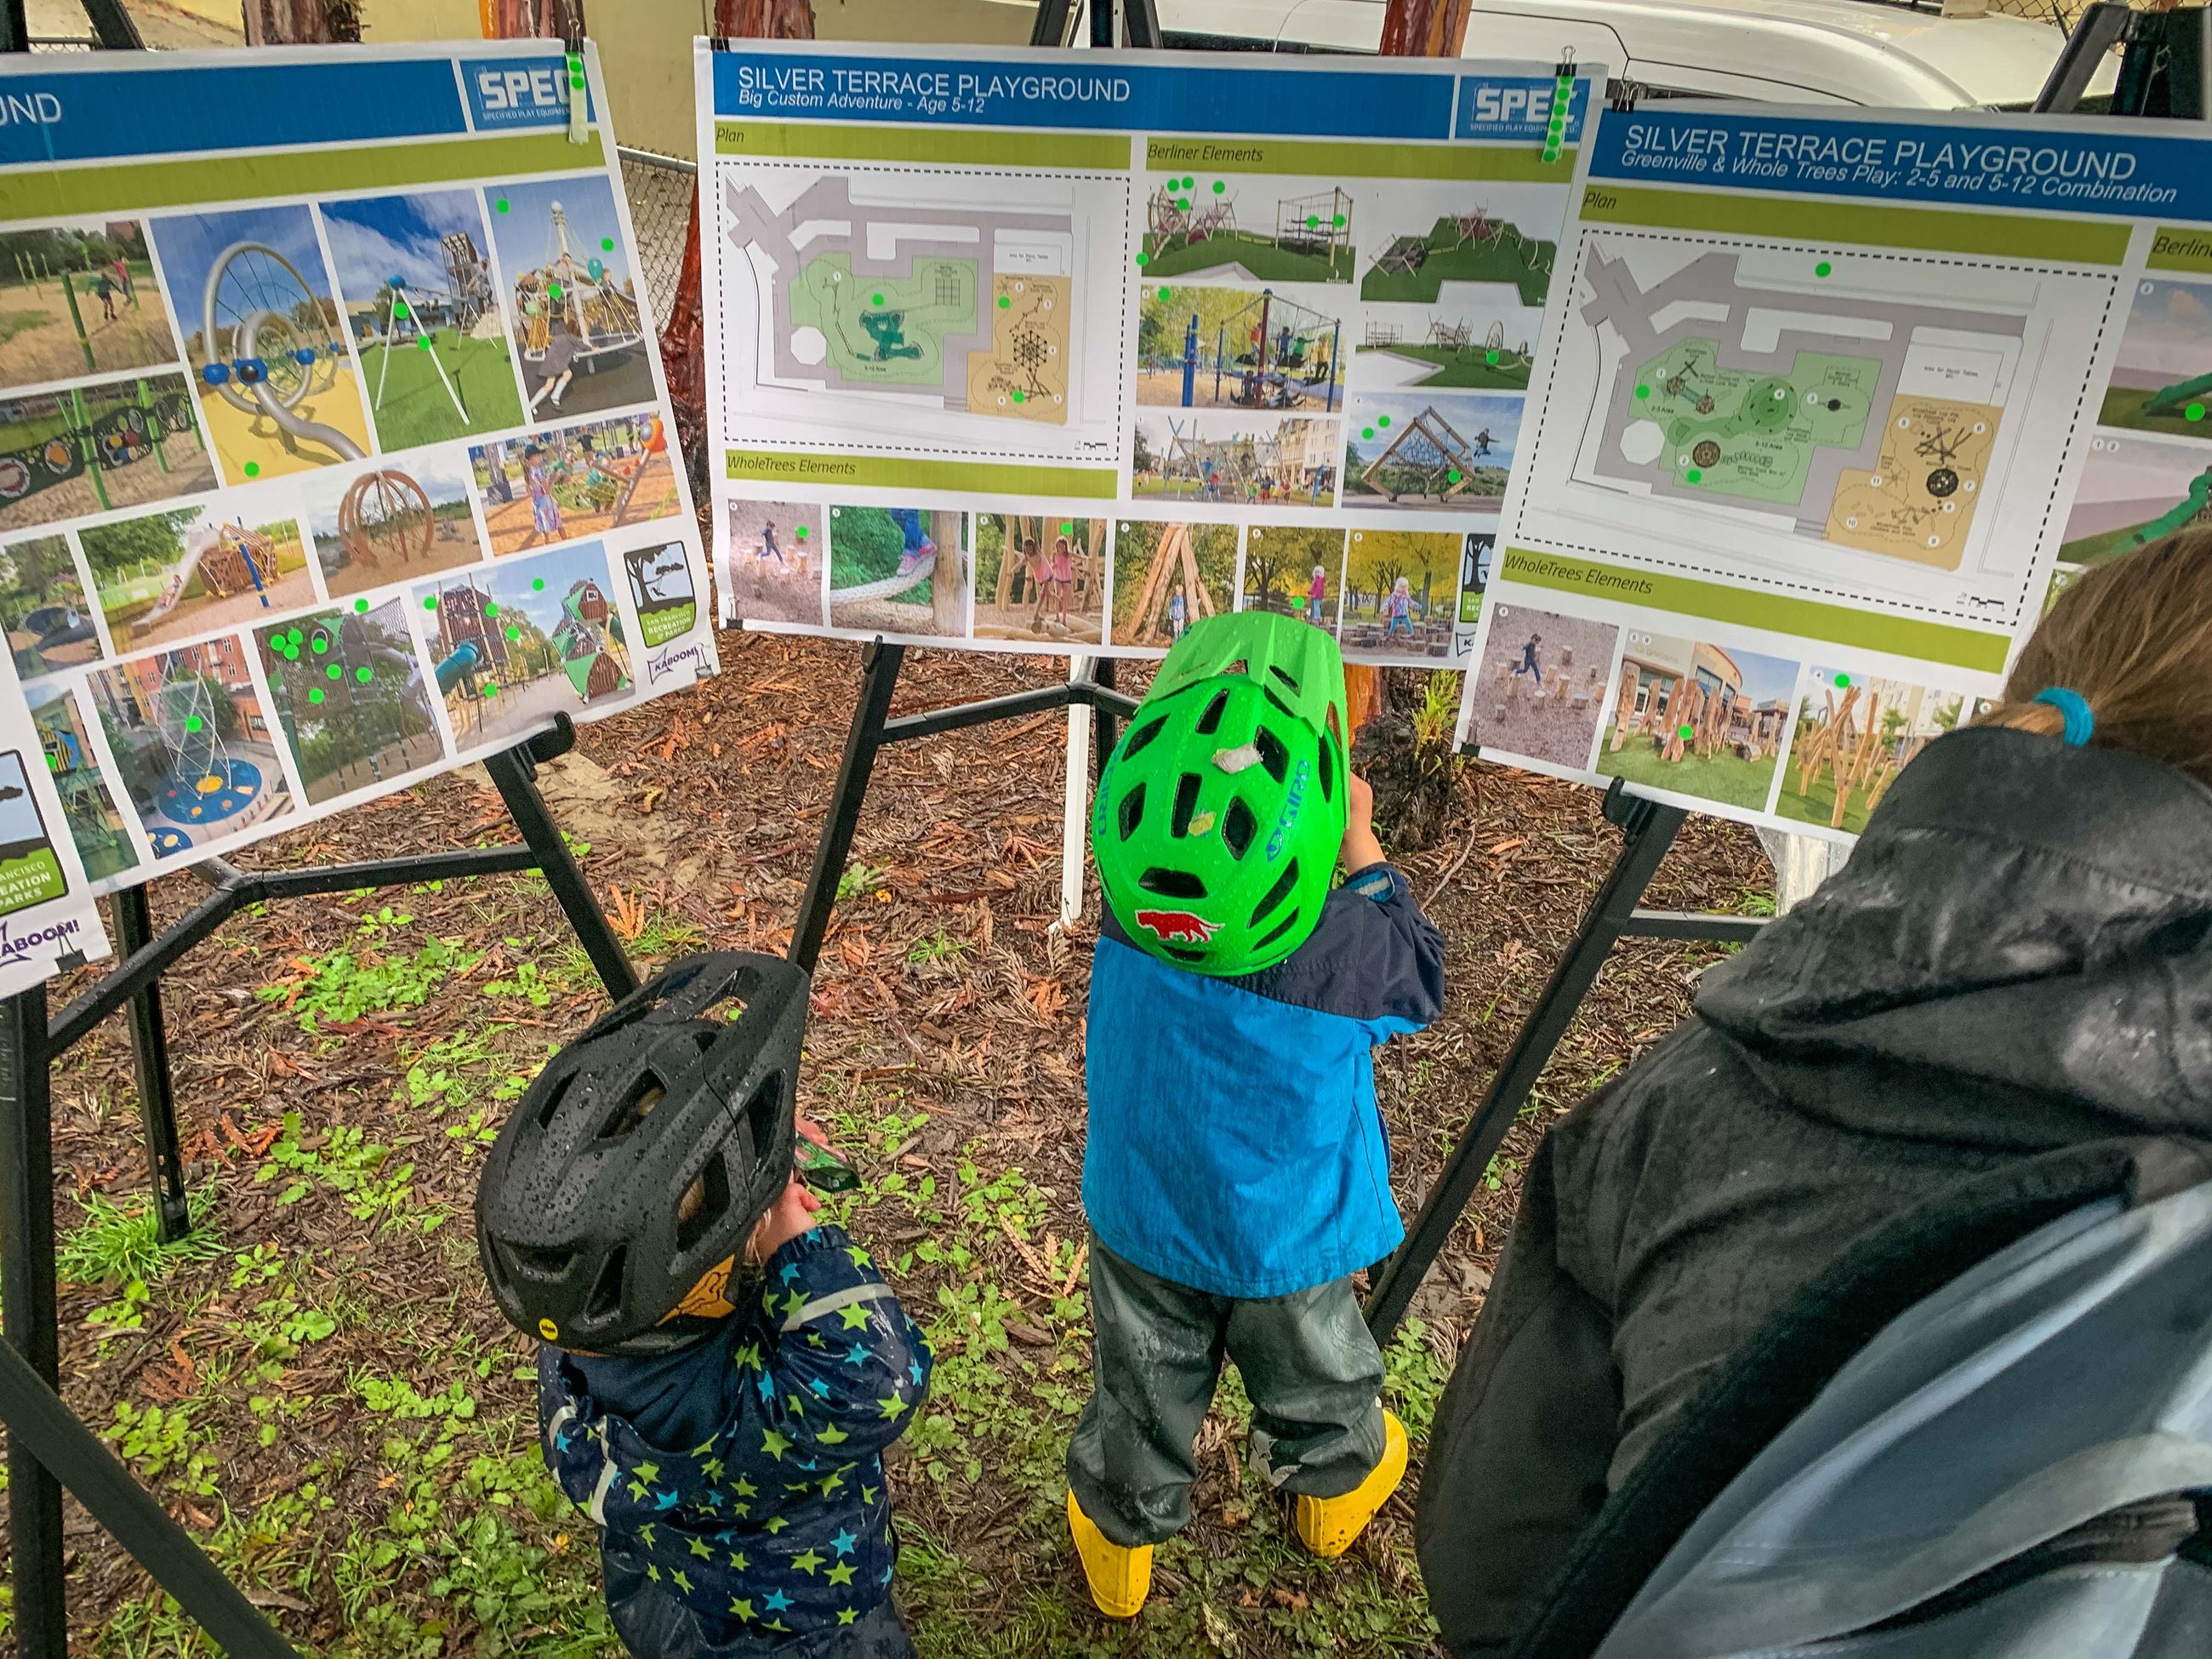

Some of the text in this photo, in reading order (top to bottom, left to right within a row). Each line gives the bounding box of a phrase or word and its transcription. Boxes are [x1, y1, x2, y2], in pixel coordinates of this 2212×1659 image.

[738, 66, 1130, 102] SILVER TERRACE PLAYGROUND
[536, 107, 570, 117] EQUIPME
[738, 89, 762, 108] Big
[767, 90, 823, 107] Custom
[828, 92, 903, 110] Adventure
[916, 96, 947, 115] Age
[951, 96, 985, 114] 5-12
[1475, 88, 1578, 123] SPE
[715, 128, 744, 143] Plan
[1505, 123, 1522, 132] PLAY
[1148, 144, 1263, 162] Berliner Elements
[1625, 124, 2137, 180] SILVER TERRACE PLAYGROUND
[1621, 148, 2177, 203] Greenville & Whole Trees Play: 2-5 and 5-12 Combination
[1583, 191, 1616, 209] Plan
[727, 455, 857, 475] WholeTrees Elements
[1505, 553, 1654, 595] WholeTrees Elements
[647, 617, 691, 634] RECREATION
[661, 610, 691, 623] FRANCISCO
[1279, 759, 1310, 830] GIRO
[0, 920, 80, 959] ABOOM!
